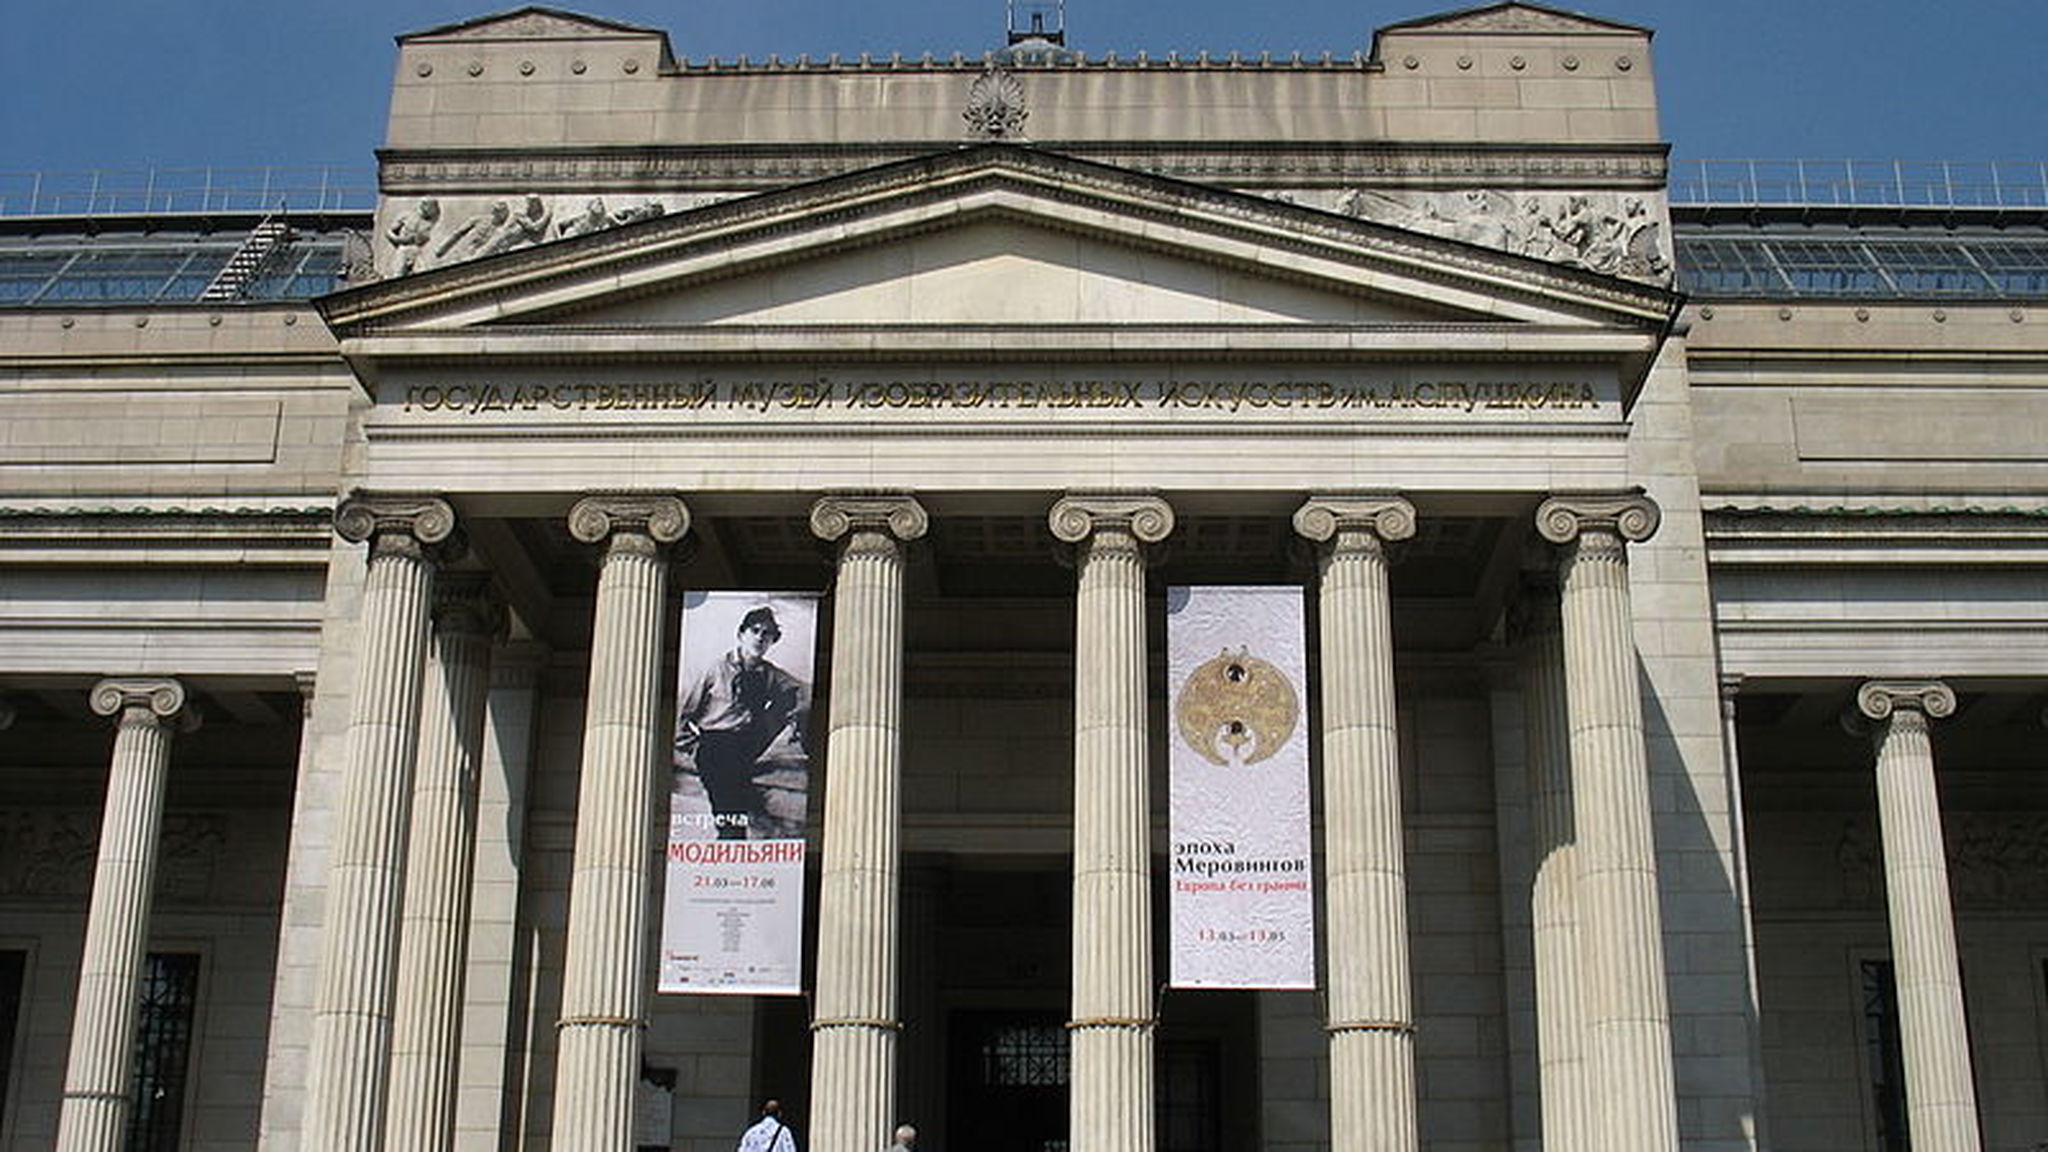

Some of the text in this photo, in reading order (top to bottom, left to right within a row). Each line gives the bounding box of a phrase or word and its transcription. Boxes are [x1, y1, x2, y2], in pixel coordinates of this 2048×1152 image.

[404, 379, 717, 414] ГОСУДАРСТВЕННЫЙ
[727, 378, 833, 413] МУЗЕЙ
[846, 380, 1143, 409] ИЗОБРАЗИТЕЛЬНЫХ
[669, 842, 803, 864] МОДИЛЬЯНИ
[1174, 842, 1235, 855] эпоха
[1174, 857, 1305, 877] Меровингов
